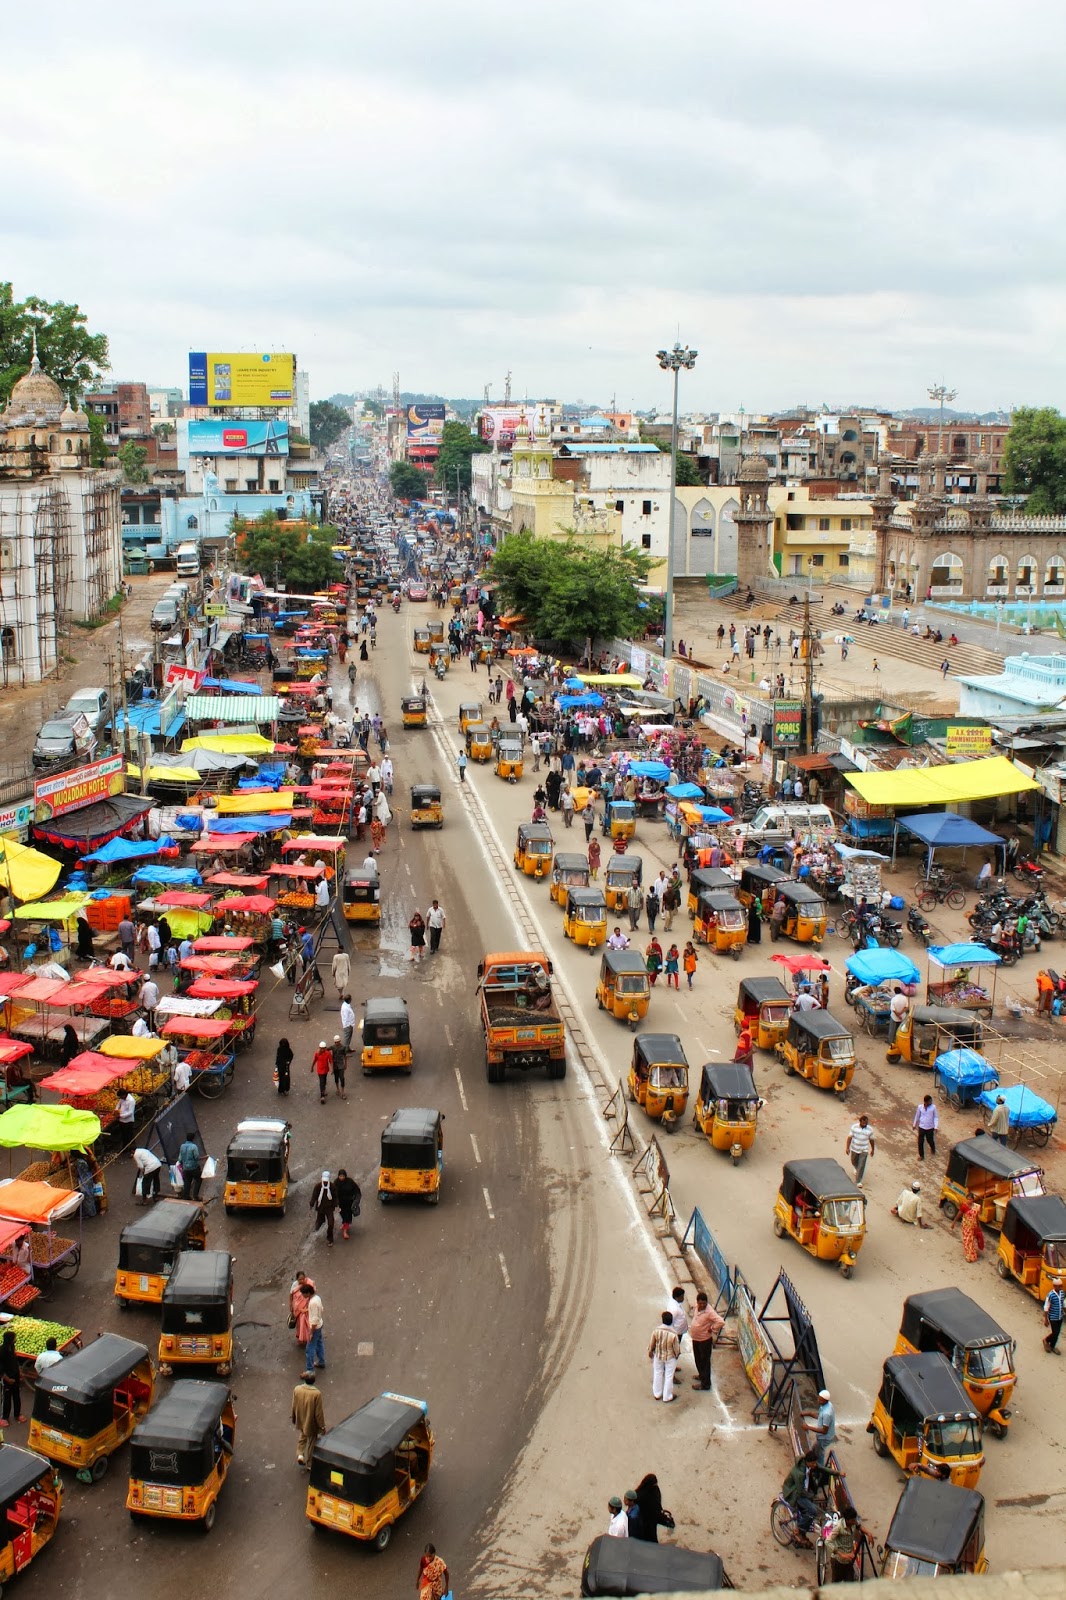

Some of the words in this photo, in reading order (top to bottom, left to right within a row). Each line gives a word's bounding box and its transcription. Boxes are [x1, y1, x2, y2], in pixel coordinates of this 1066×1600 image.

[775, 722, 800, 734] PEARLS
[53, 784, 88, 807] MUQADDAR
[88, 776, 107, 793] HOTEL
[0, 819, 16, 828] HOP
